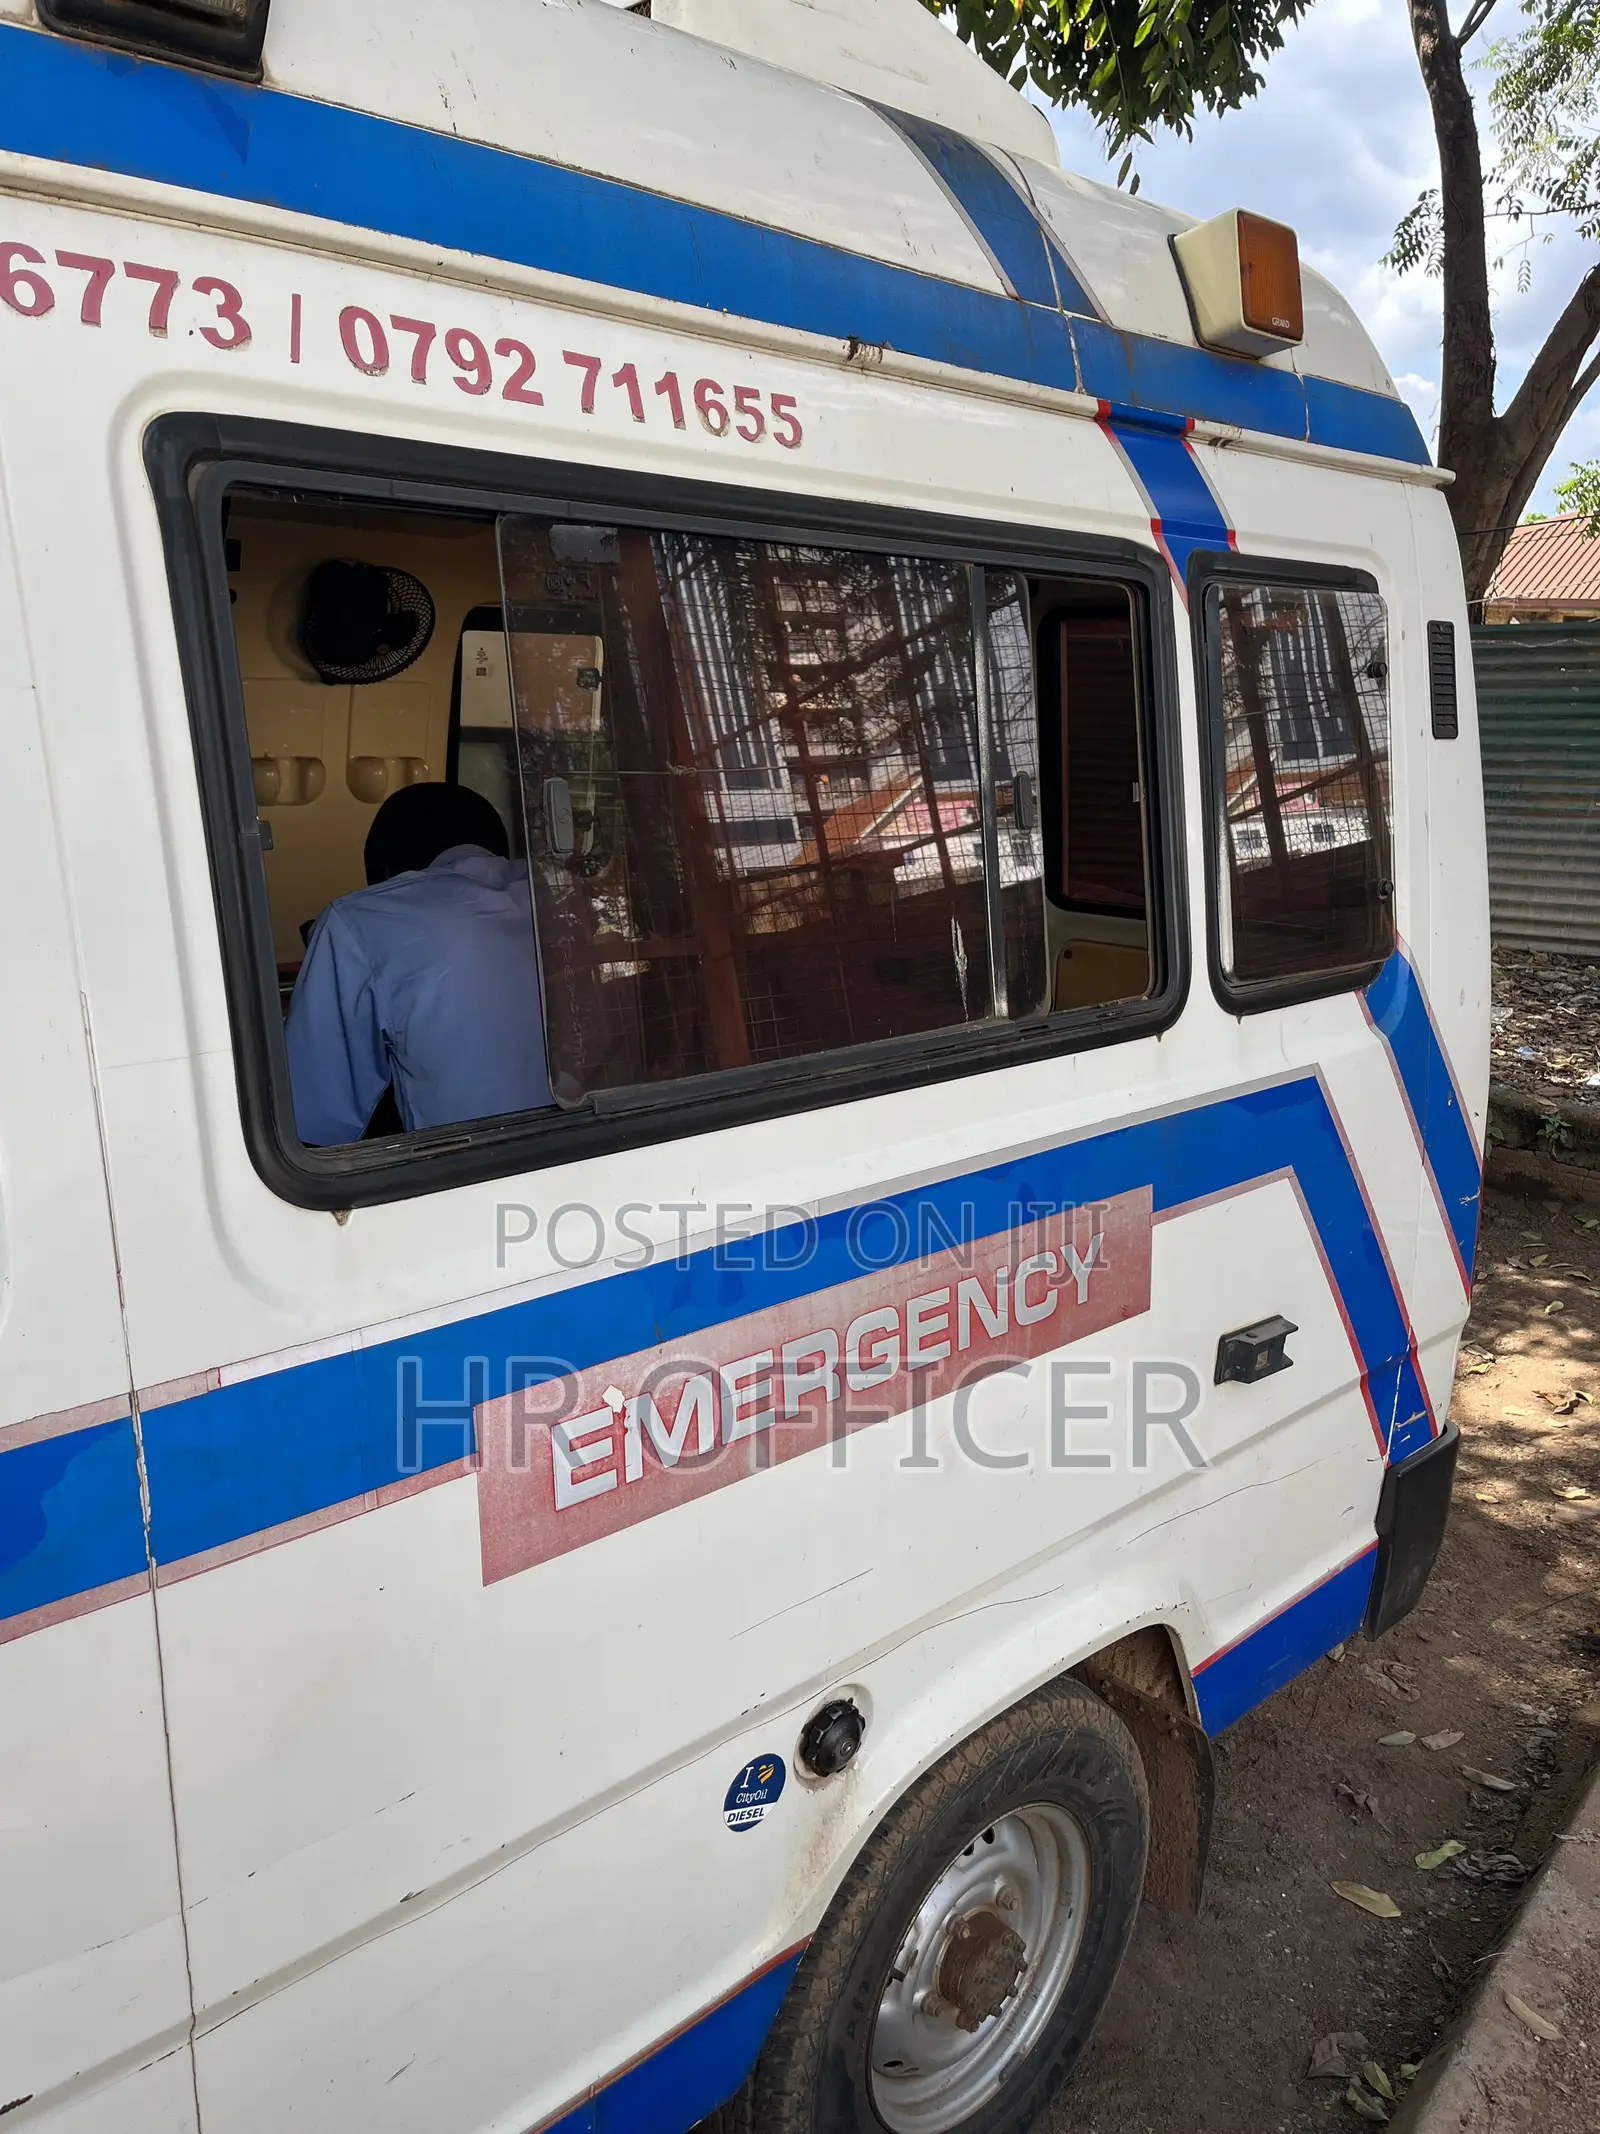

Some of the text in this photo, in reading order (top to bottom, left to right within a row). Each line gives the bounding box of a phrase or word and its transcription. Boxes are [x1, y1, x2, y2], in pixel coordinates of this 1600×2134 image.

[1, 241, 252, 349] 6773
[338, 305, 545, 407] 0792
[562, 349, 802, 449] 711655
[553, 1232, 1105, 1512] EMERGENCY
[727, 1807, 765, 1823] DIESEL
[735, 1789, 768, 1804] CityOil
